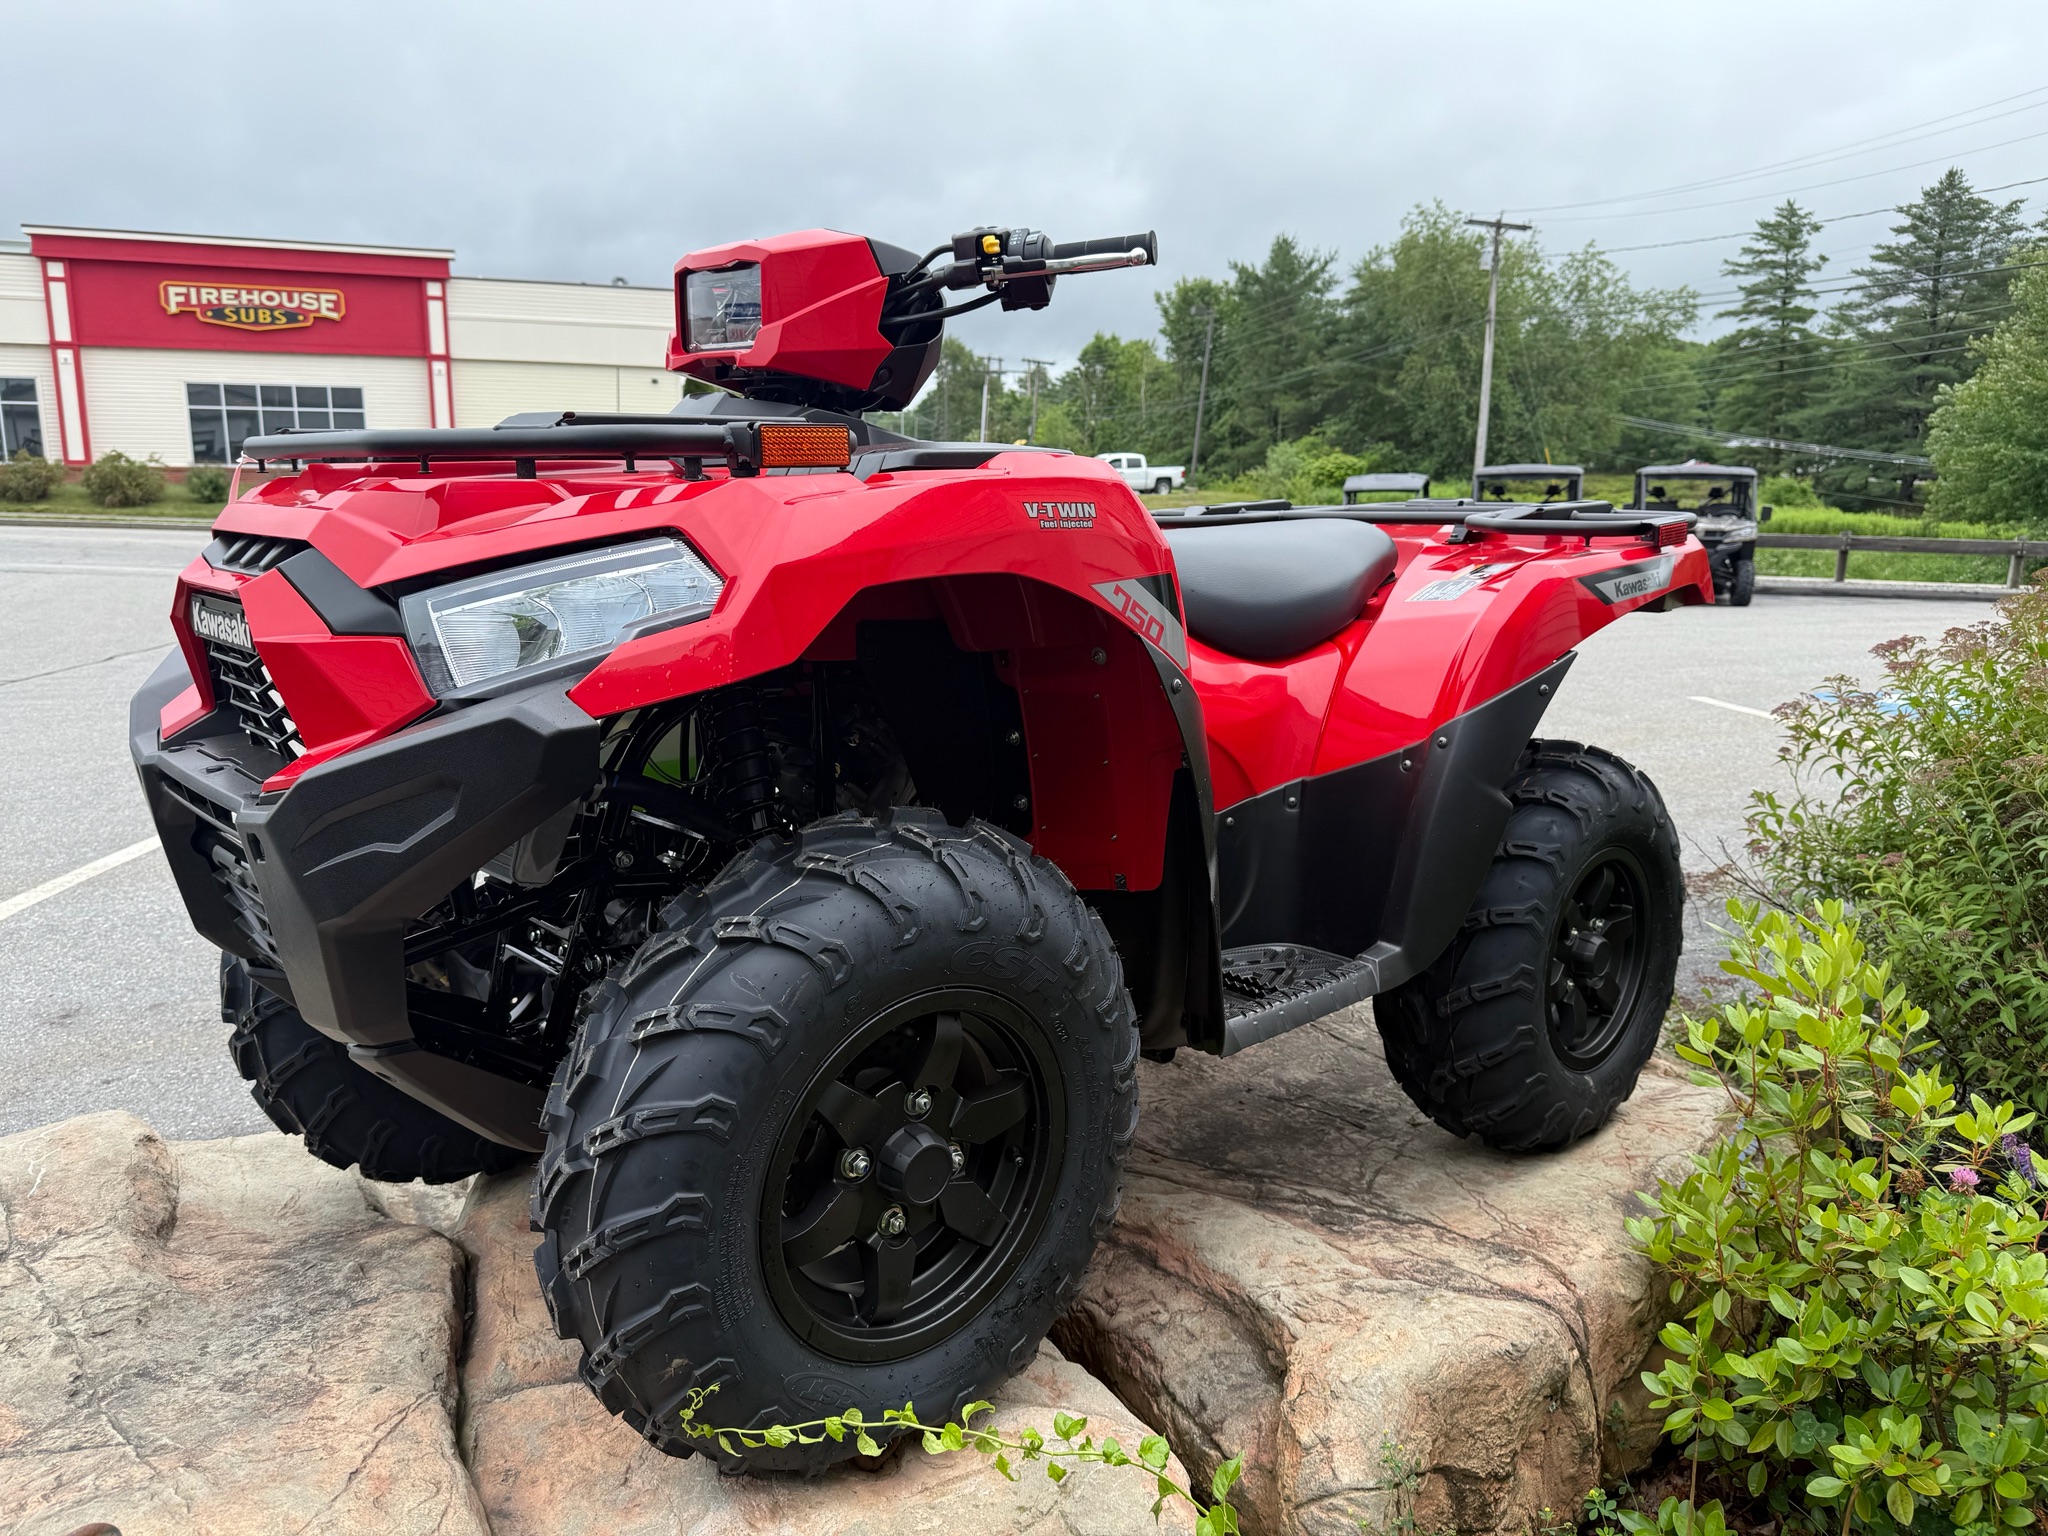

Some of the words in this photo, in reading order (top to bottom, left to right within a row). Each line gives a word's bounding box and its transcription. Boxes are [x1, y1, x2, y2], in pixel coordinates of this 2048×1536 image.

[167, 285, 339, 318] FIREHOUSE
[223, 307, 287, 325] SUBS
[1022, 502, 1097, 519] V-TWIN
[1040, 519, 1058, 529] Fuel
[1060, 519, 1093, 529] Injected
[192, 601, 252, 649] Kawasaki
[1113, 584, 1165, 646] 750
[951, 940, 1060, 993] CST
